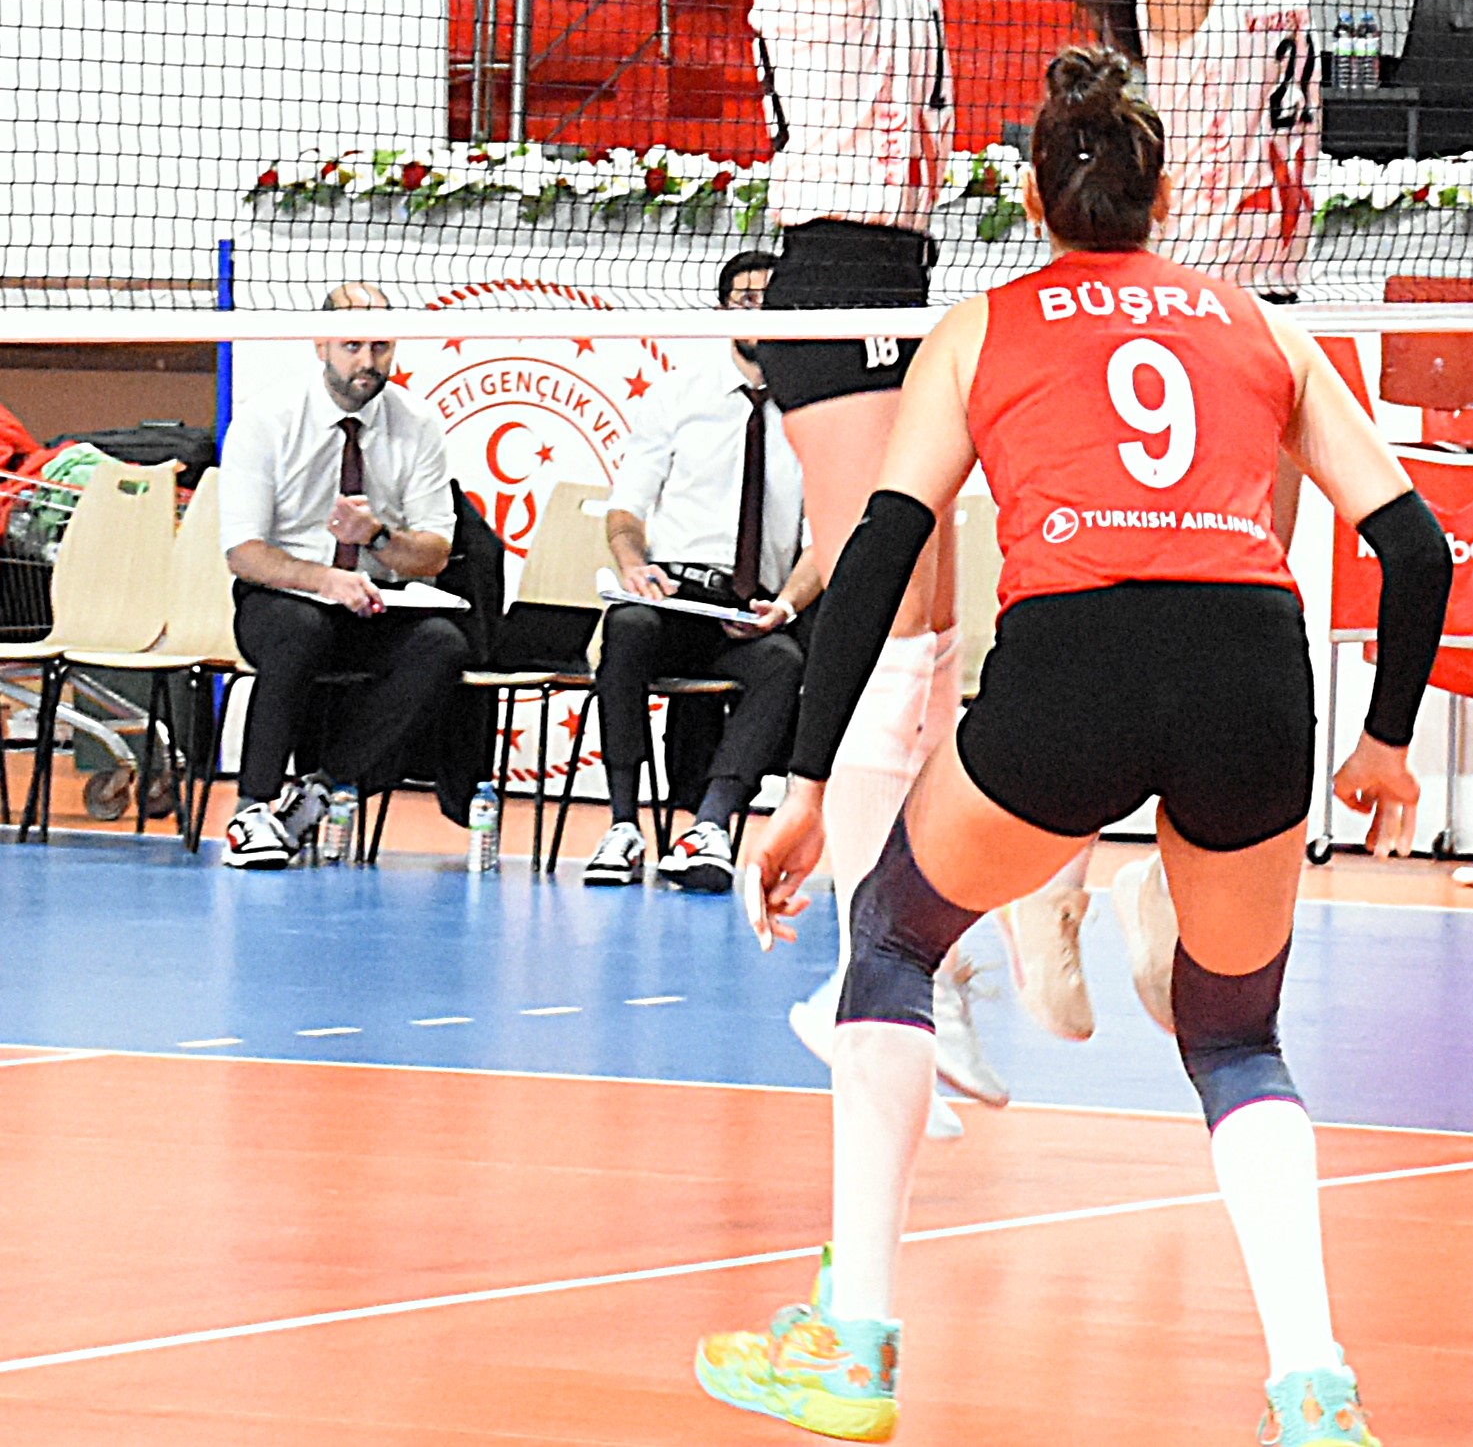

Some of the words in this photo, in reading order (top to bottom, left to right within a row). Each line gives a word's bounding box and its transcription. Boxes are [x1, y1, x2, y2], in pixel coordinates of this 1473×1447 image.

[1038, 281, 1231, 324] BÜŞRA
[865, 336, 900, 370] 18
[480, 370, 592, 418] GENÇLİK
[592, 411, 621, 451] VE
[1107, 338, 1197, 488] 9
[1082, 510, 1177, 528] TURKISH
